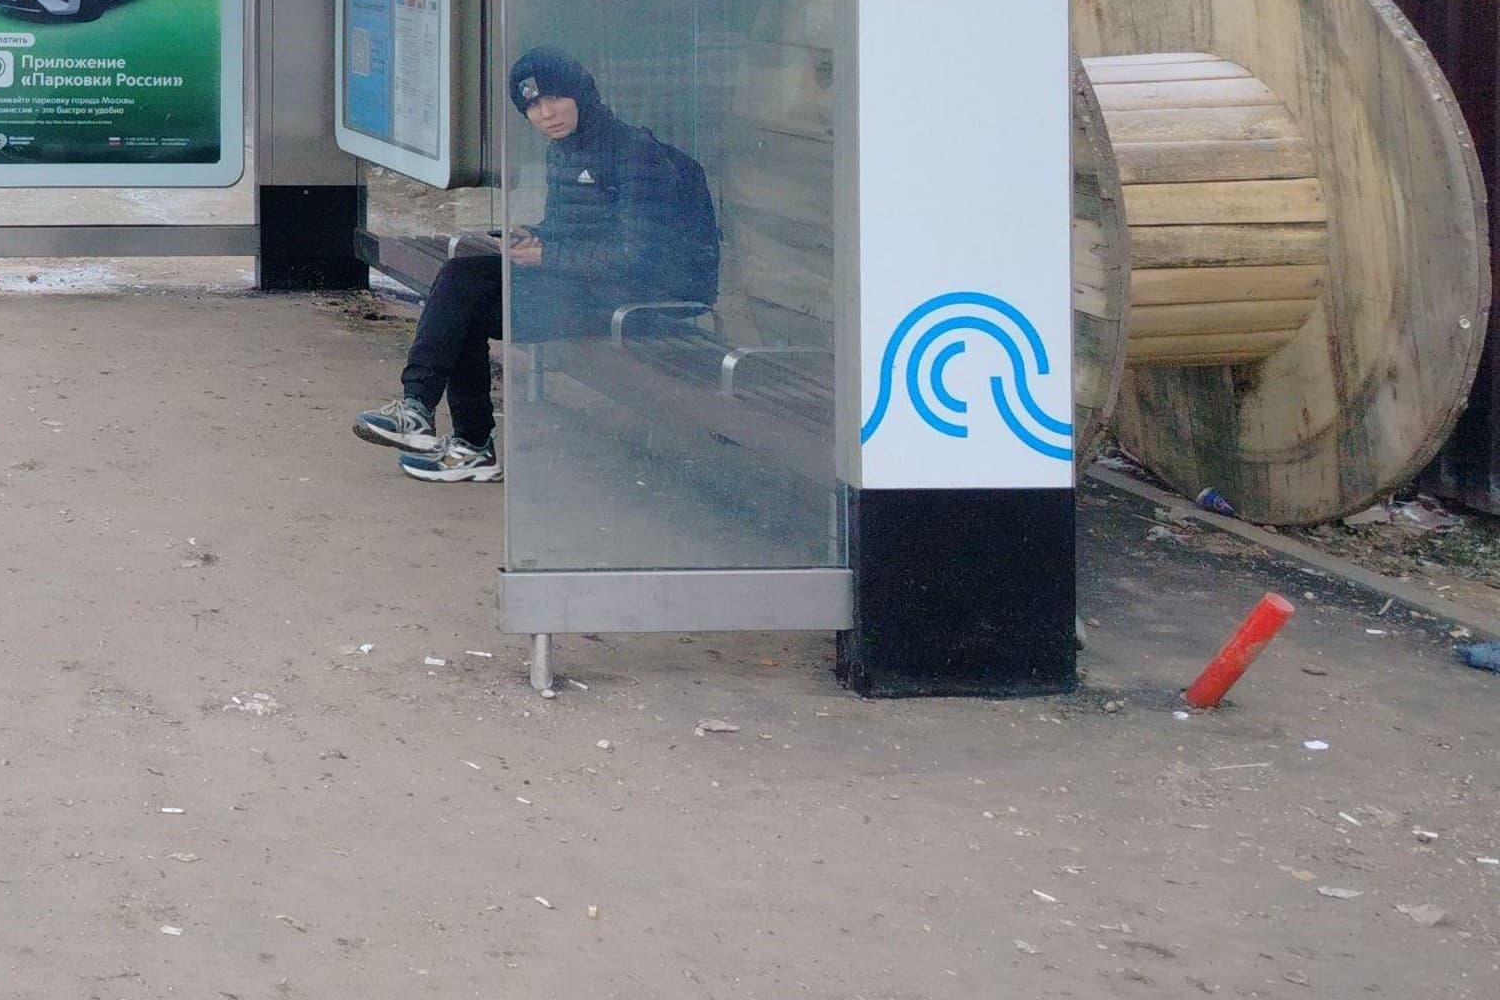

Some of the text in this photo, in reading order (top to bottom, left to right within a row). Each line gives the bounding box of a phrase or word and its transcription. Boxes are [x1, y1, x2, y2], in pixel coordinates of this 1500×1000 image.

[21, 54, 126, 71] Приложение
[21, 72, 184, 89] «Парковки России»
[32, 97, 69, 106] парковку
[71, 97, 100, 106] города
[101, 97, 135, 105] Москвы
[42, 107, 55, 115] это
[56, 105, 86, 117] быстро
[94, 105, 124, 116] удобно
